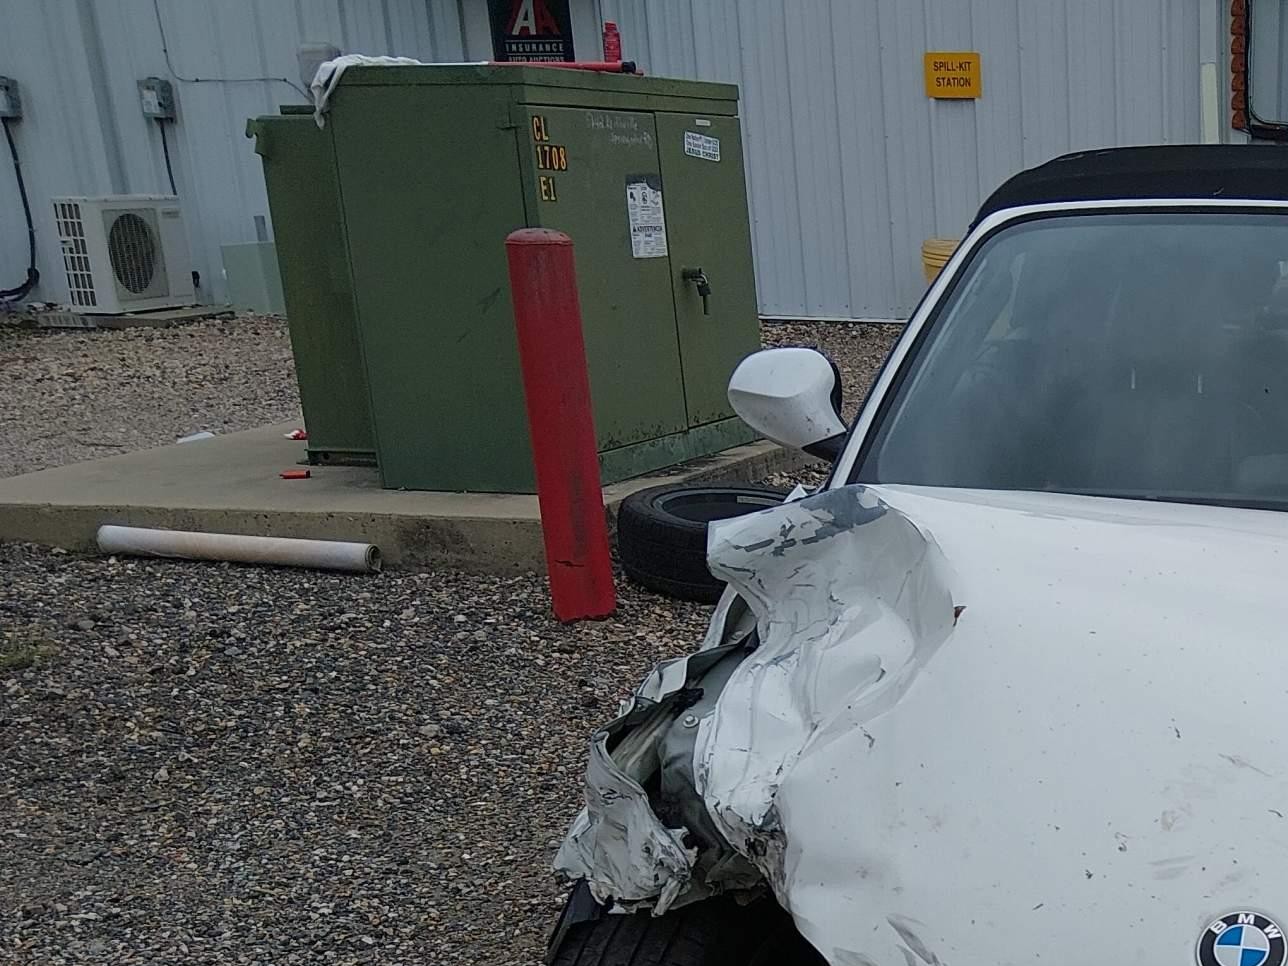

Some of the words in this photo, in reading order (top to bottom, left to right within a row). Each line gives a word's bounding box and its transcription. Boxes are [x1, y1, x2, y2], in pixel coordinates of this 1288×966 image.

[505, 43, 564, 52] INSURANCE
[933, 61, 972, 72] SPILL-KIT
[935, 77, 972, 88] STATION
[532, 116, 549, 140] CL
[536, 146, 567, 170] 1708
[540, 176, 556, 201] E1
[1210, 913, 1282, 939] BMW
